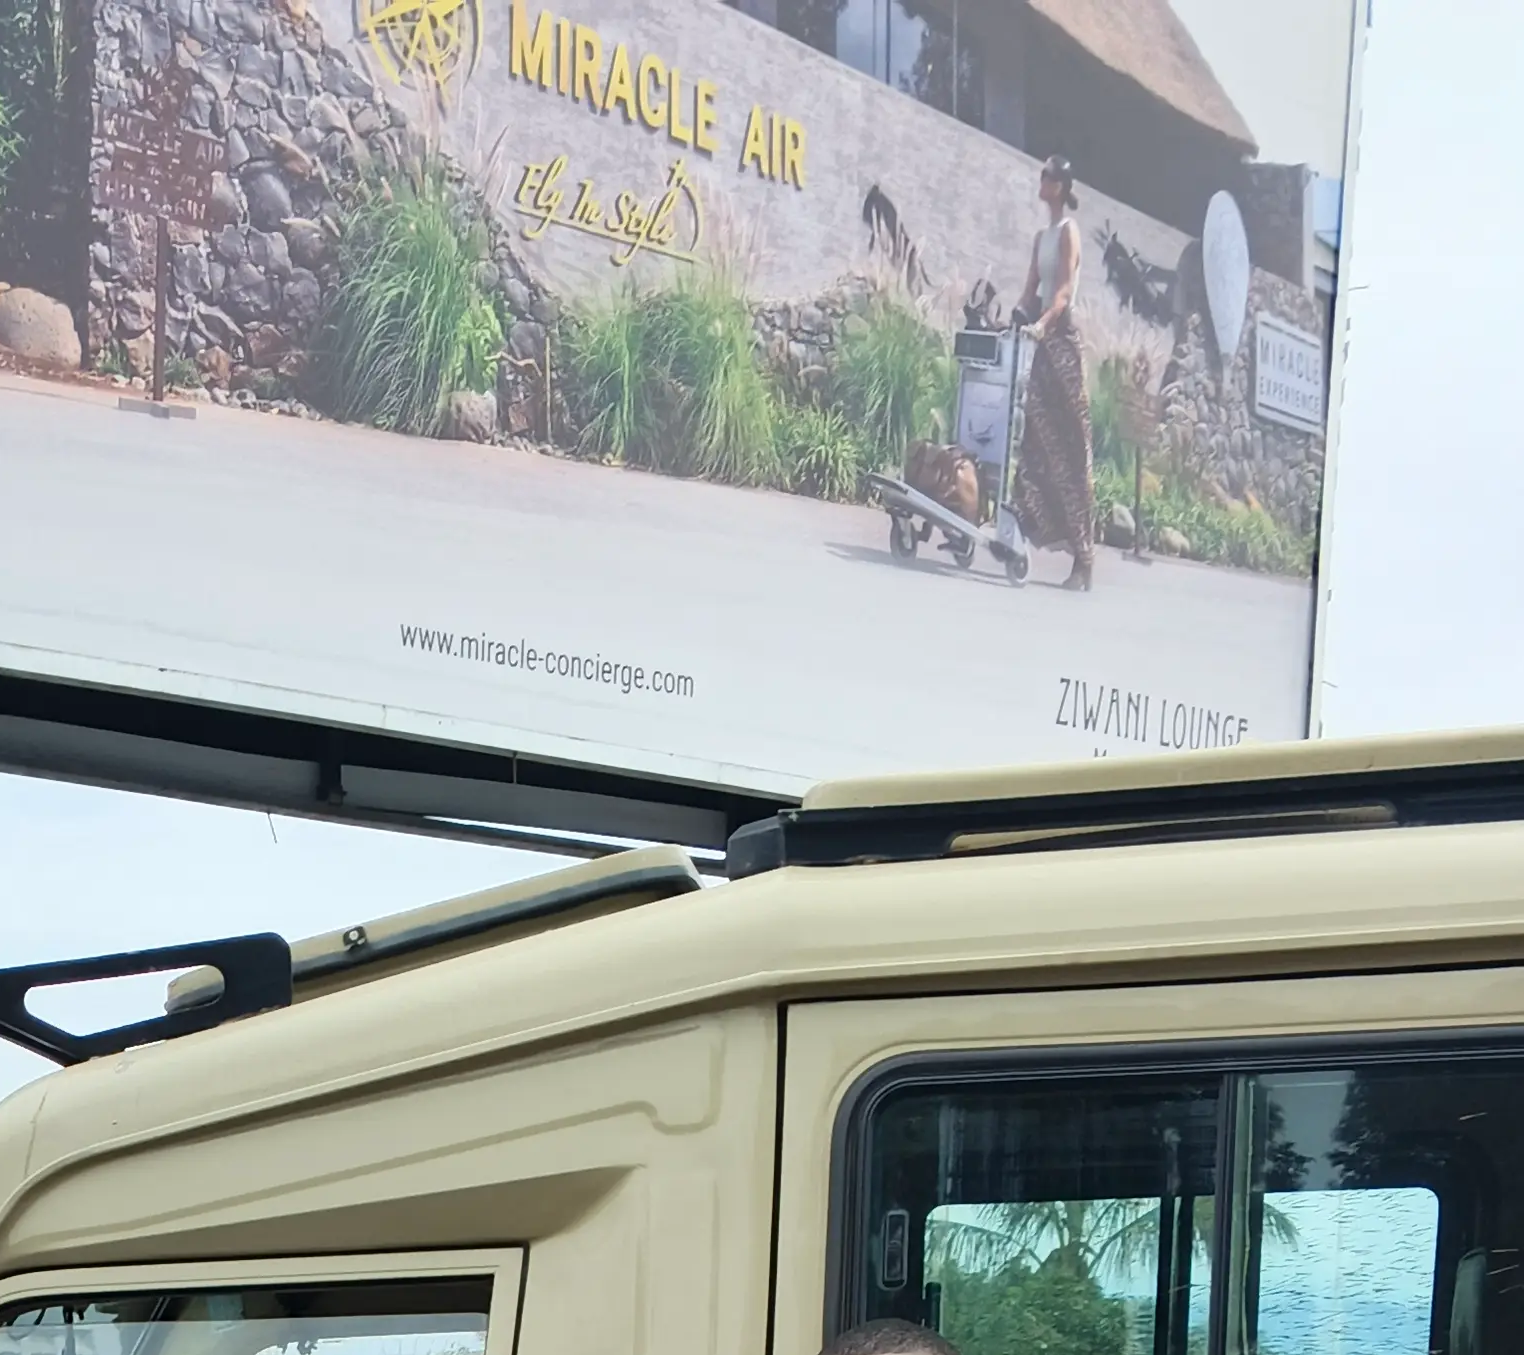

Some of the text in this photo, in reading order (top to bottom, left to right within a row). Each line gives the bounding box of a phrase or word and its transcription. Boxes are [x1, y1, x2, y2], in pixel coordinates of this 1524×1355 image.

[510, 3, 807, 190] MIRACLE AIR
[400, 623, 694, 698] www.miracle-concierge.com
[1055, 677, 1150, 743] ZIWANI
